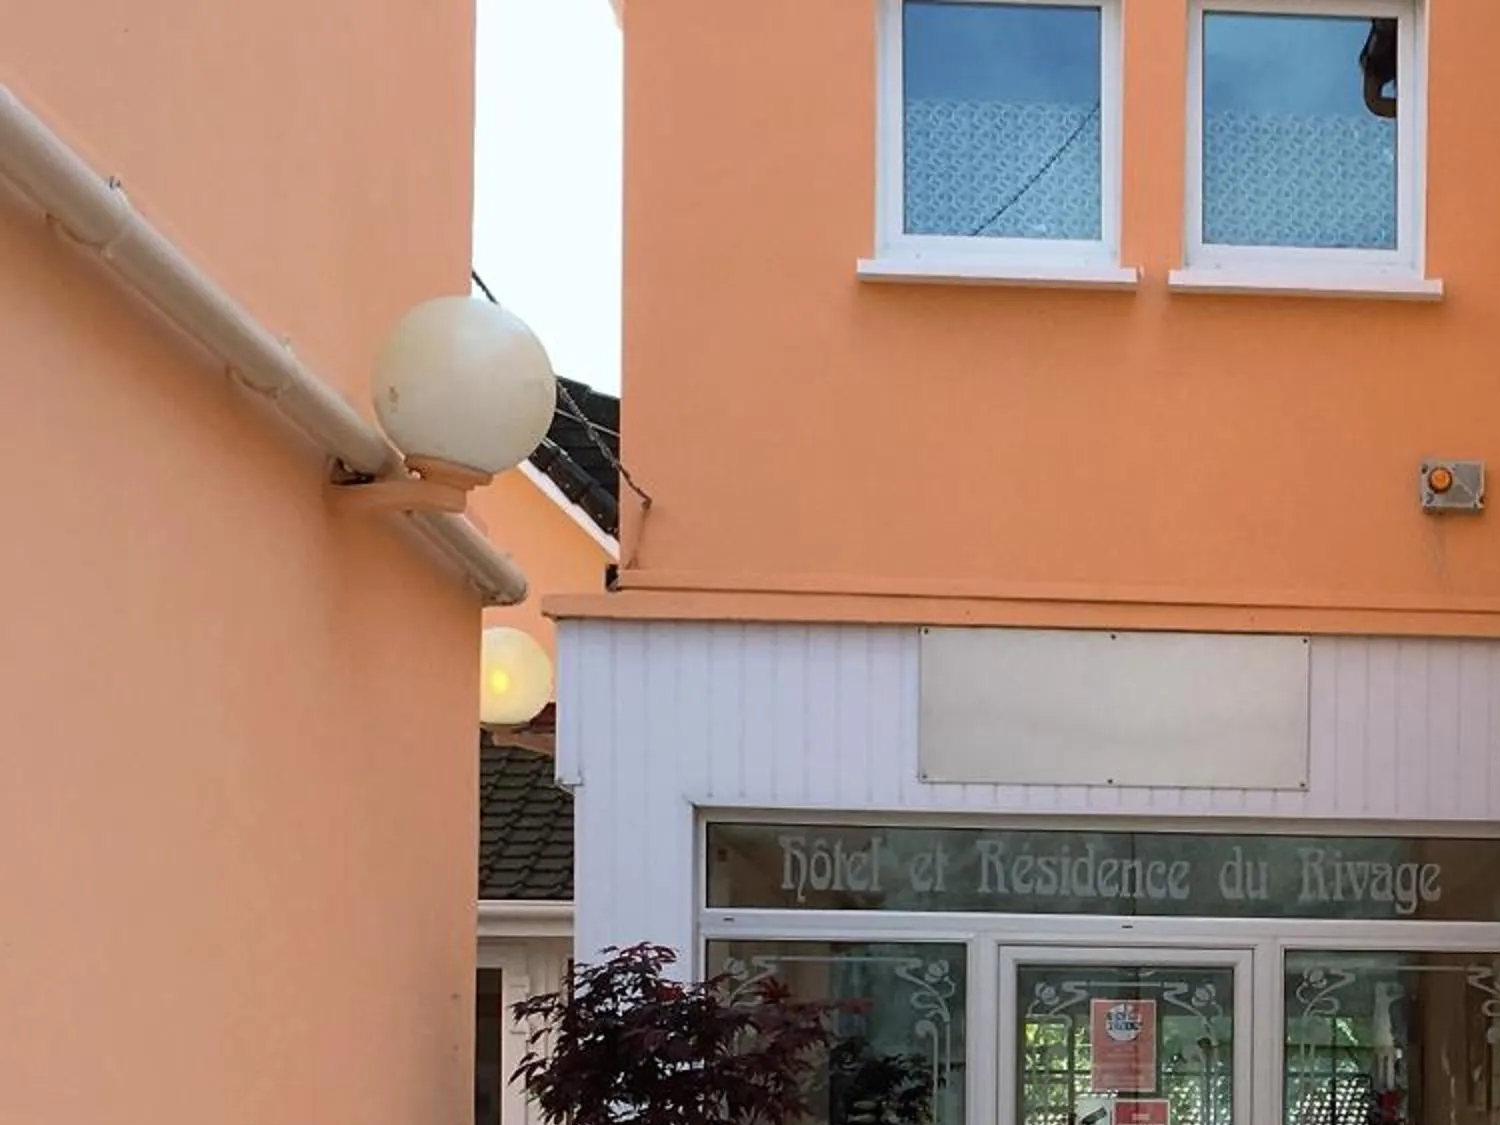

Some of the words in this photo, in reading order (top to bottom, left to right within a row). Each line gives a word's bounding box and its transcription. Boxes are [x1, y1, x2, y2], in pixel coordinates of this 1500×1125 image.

[908, 838, 949, 892] et
[974, 839, 1191, 900] Résidence
[1218, 846, 1270, 900] du
[1297, 847, 1442, 915] Rivage
